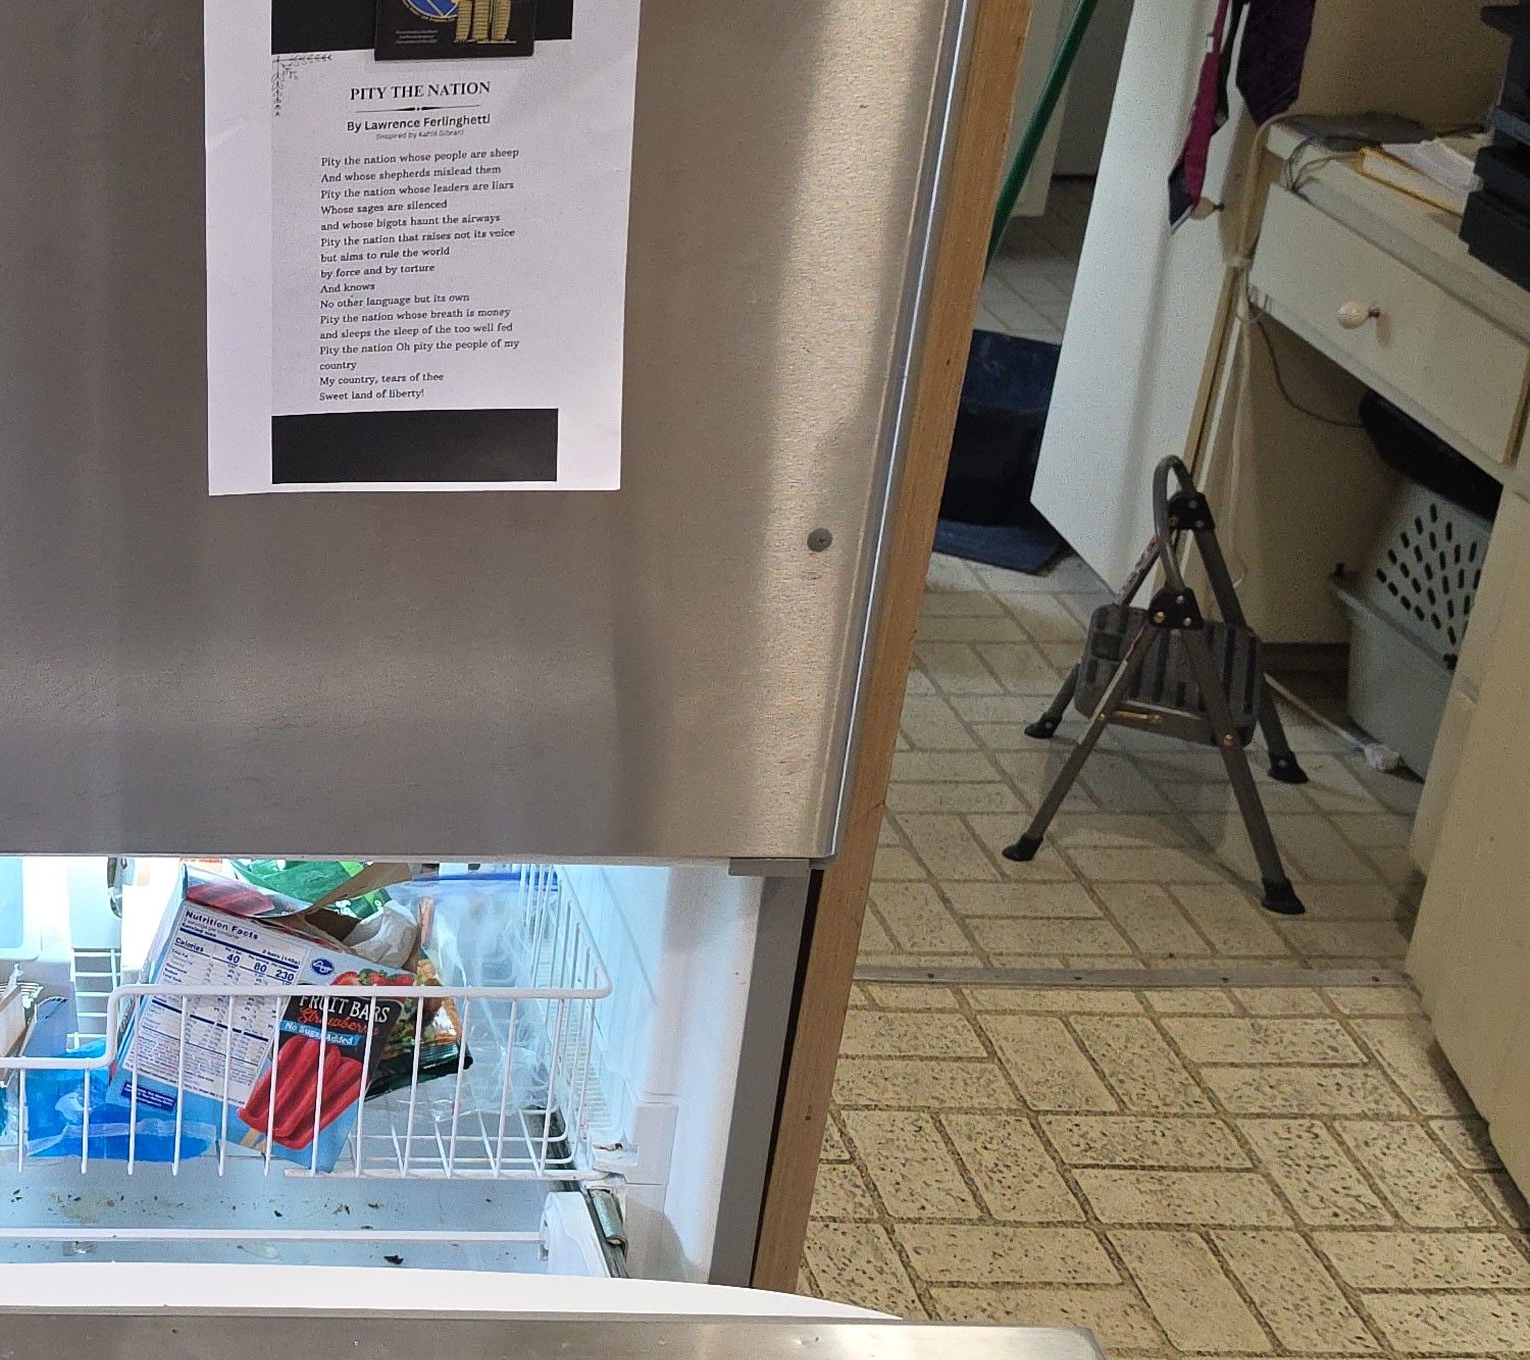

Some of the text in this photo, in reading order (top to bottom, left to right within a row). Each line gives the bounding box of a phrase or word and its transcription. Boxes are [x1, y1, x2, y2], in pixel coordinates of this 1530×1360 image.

[350, 80, 491, 101] PITY THE NATION
[347, 113, 491, 133] By Lawrence Ferlinghetti
[321, 148, 519, 168] Pity the nation whose people are sheep
[321, 165, 501, 183] And whose shepherds mislead them
[320, 372, 444, 387] My country, tears of thee
[319, 388, 425, 402] Sweet land of liberty!
[185, 910, 258, 940] Nutrition Facts
[175, 937, 204, 953] Calories
[226, 953, 295, 982] 40 80 230
[298, 995, 391, 1023] FRUIT BARS
